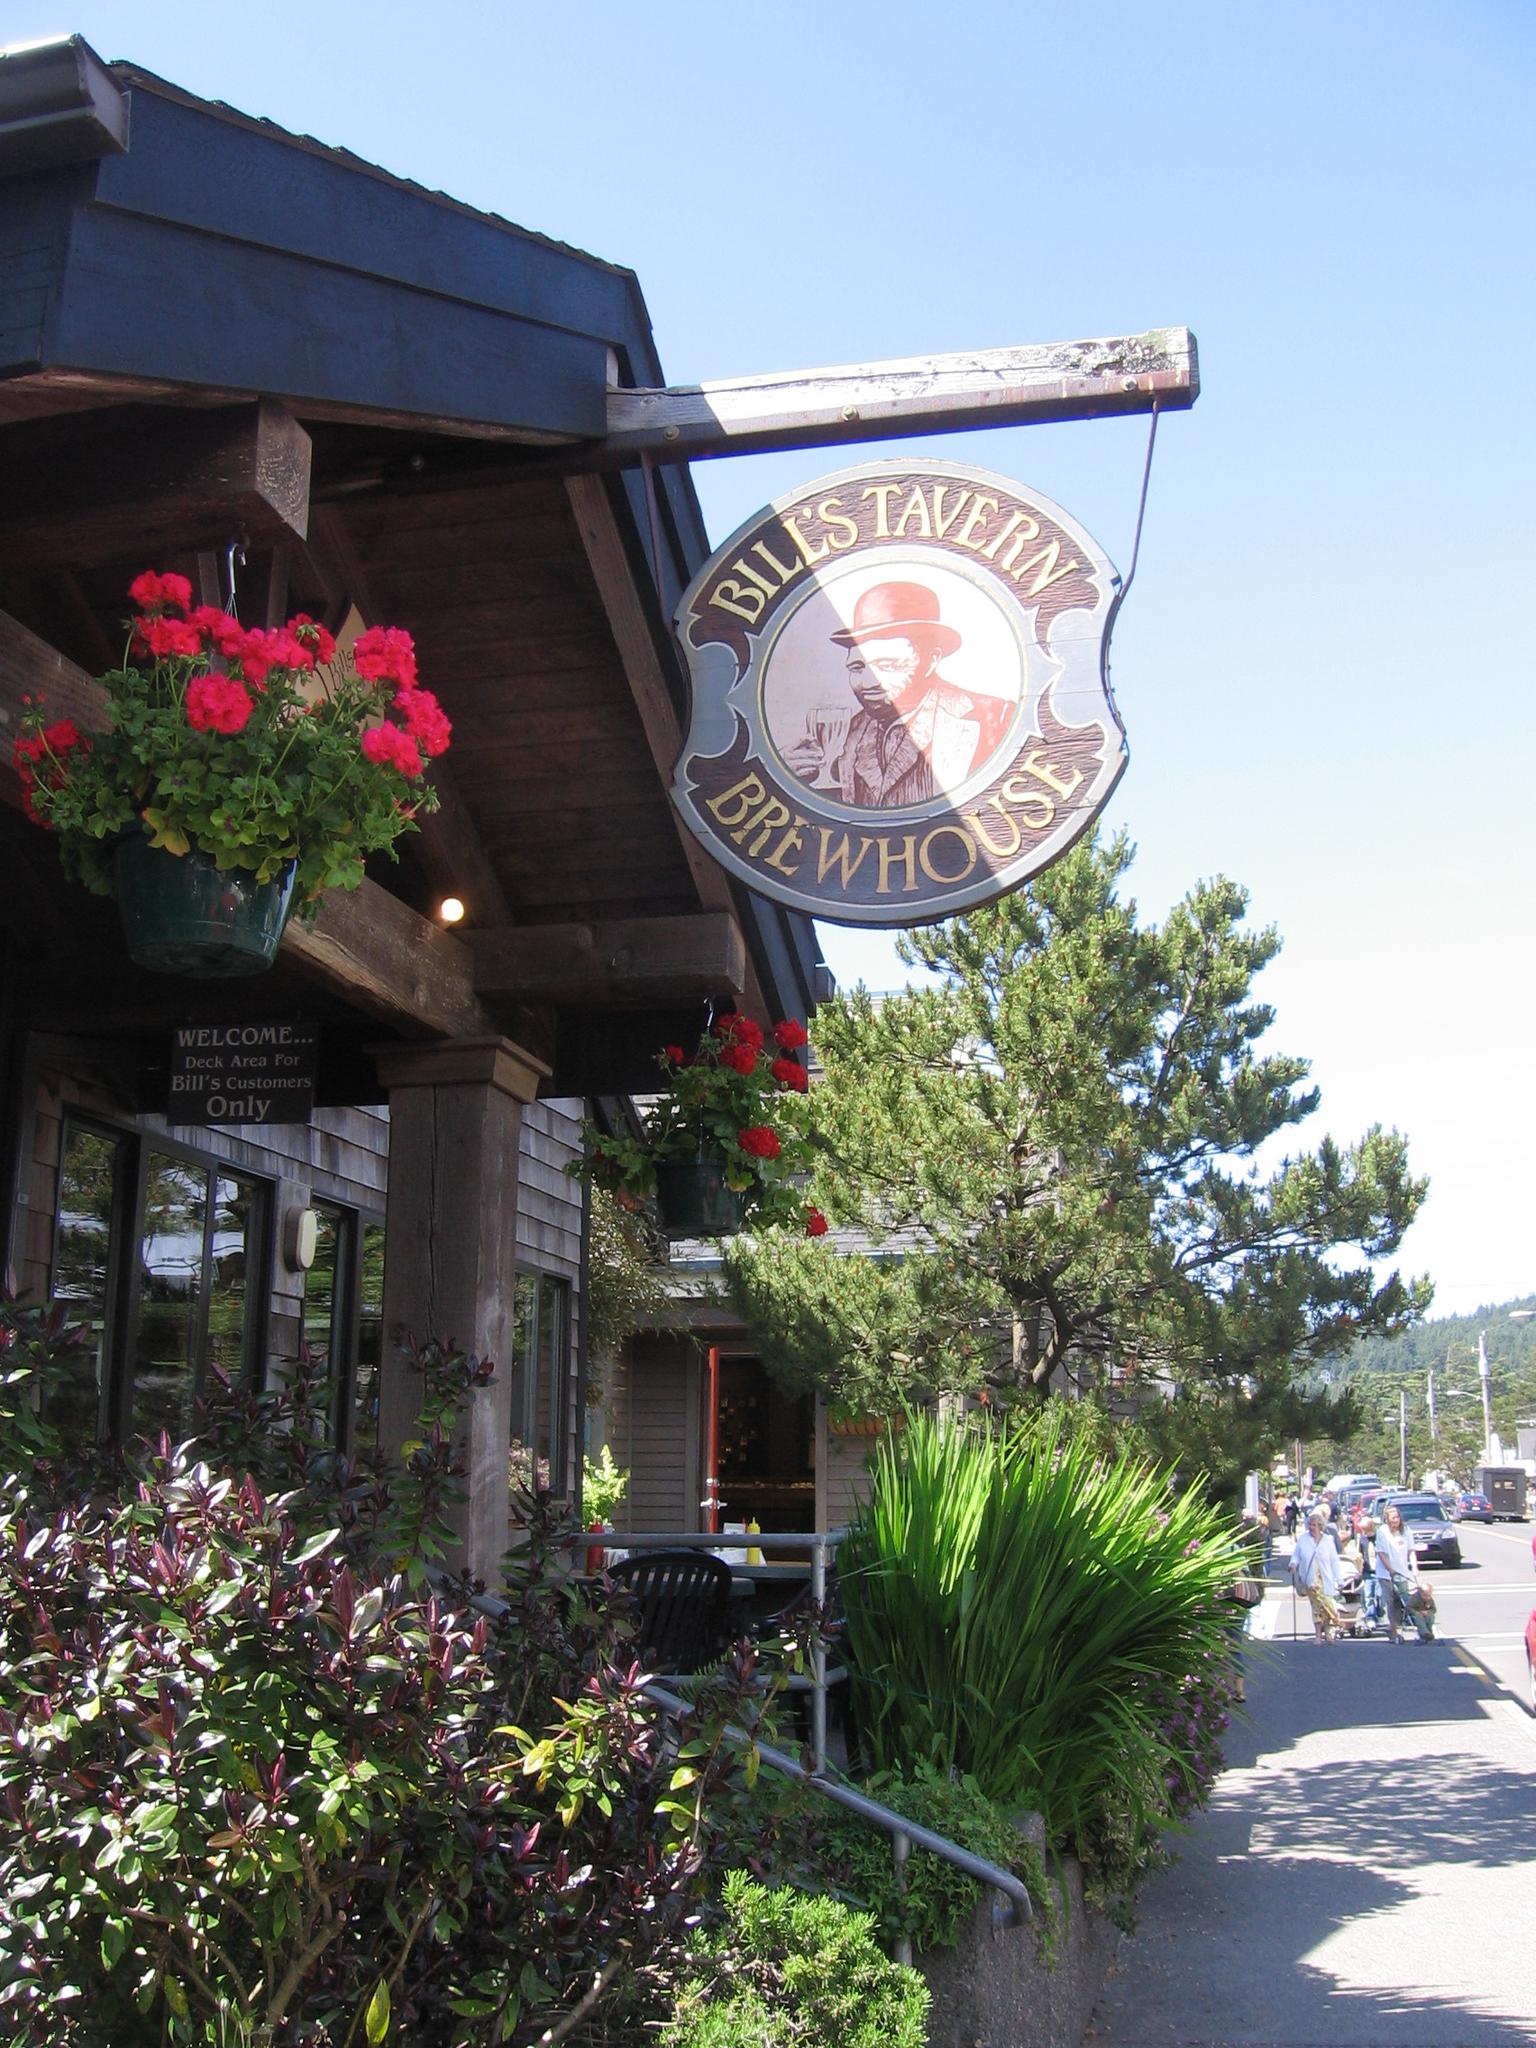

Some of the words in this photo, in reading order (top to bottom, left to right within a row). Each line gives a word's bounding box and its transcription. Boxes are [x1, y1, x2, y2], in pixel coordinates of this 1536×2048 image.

[708, 497, 860, 625] BILL'S
[862, 484, 1080, 598] TAVERN
[705, 750, 1084, 894] BREWHOUSE
[177, 1026, 313, 1048] WELCOME...
[185, 1056, 224, 1069] Deck
[230, 1055, 267, 1067] Area
[274, 1053, 301, 1066] For
[171, 1074, 221, 1091] Bill's
[226, 1076, 312, 1090] Customers
[206, 1095, 272, 1122] Only
